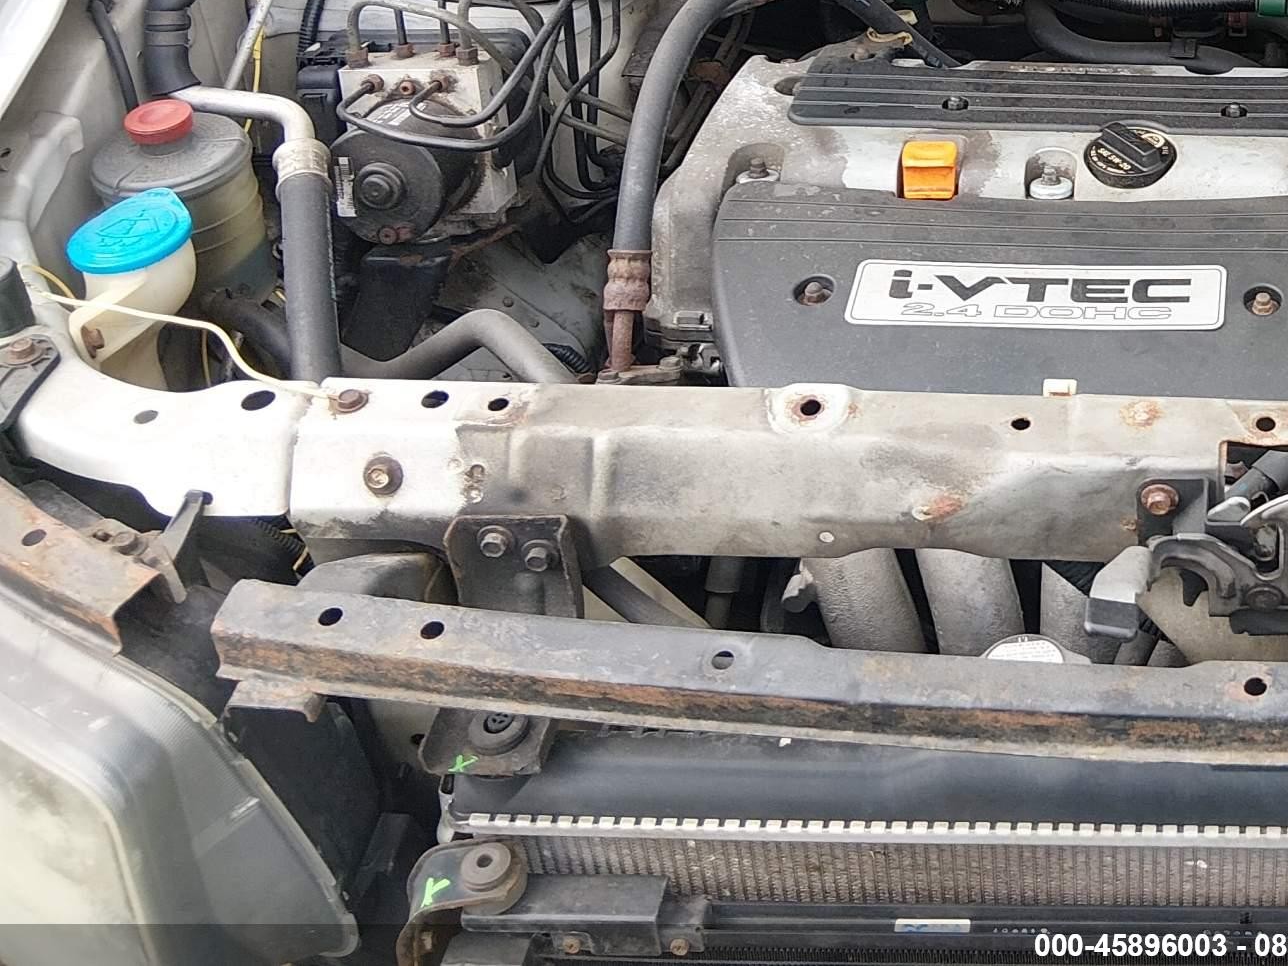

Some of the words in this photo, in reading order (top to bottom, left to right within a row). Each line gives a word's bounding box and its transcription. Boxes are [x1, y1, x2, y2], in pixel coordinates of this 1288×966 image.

[889, 269, 1192, 304] i-VTEC
[900, 302, 982, 318] 2.4
[993, 304, 1172, 321] DOHC
